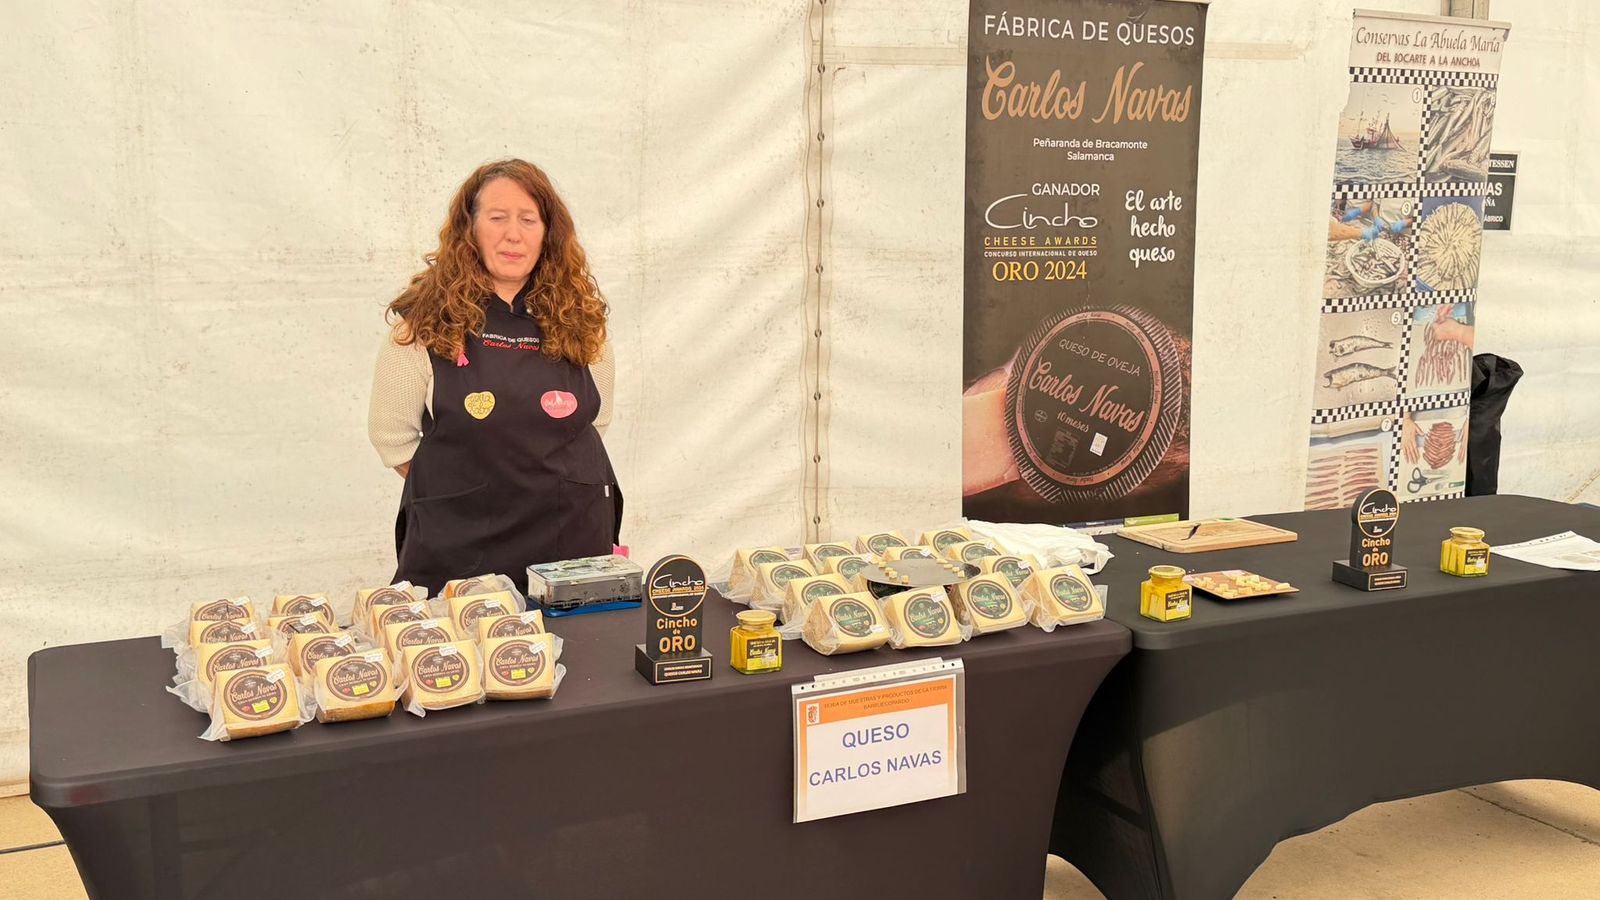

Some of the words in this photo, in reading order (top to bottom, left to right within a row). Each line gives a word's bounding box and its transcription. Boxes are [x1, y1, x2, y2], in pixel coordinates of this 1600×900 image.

[984, 11, 1074, 40] FÁBRICA
[1082, 21, 1109, 41] DE
[1116, 23, 1195, 46] QUESOS
[1356, 26, 1410, 49] Conservas
[1413, 31, 1428, 48] La
[1430, 32, 1467, 51] Abuela
[1470, 35, 1500, 53] María
[1376, 52, 1391, 63] DEL
[1394, 53, 1426, 64] BOCARTE
[1429, 55, 1436, 65] A
[1438, 55, 1449, 66] LA
[1450, 56, 1481, 68] ANCHOA
[981, 55, 1087, 121] Carlos
[1091, 61, 1193, 124] Navas
[1033, 138, 1080, 149] Peñaranda
[1082, 139, 1094, 149] de
[1095, 139, 1148, 150] Bracamonte
[1067, 151, 1115, 161] Salamanca
[1032, 183, 1100, 196] GANADOR
[1125, 189, 1145, 212] El
[1150, 190, 1183, 212] arte
[984, 193, 1098, 230] Cincho
[1130, 215, 1176, 238] hecho
[984, 236, 1036, 246] CHEESE
[1044, 236, 1098, 246] AWARDS
[984, 250, 1018, 258] CONCURSO
[1019, 250, 1066, 258] INTERNACIONAL
[1129, 246, 1176, 269] queso
[992, 261, 1039, 281] ORO
[1044, 260, 1088, 280] 2024
[1059, 338, 1090, 357] QUESO
[1090, 350, 1106, 363] DE
[1107, 356, 1141, 377] OVEJA
[1029, 356, 1084, 406] Carlos
[1079, 384, 1145, 433] Navas
[1361, 502, 1397, 515] Cincho
[1362, 538, 1391, 548] Cincho
[1362, 552, 1388, 567] ORO
[653, 574, 704, 588] Cincho
[656, 616, 698, 630] Cincho
[659, 634, 696, 654] ORO
[496, 656, 517, 666] Carlos
[518, 650, 539, 664] Navas
[418, 664, 440, 674] Carlos
[441, 660, 462, 672] Navas
[334, 673, 356, 684] Carlos
[357, 668, 378, 680] Navas
[232, 688, 255, 700] Carlos
[256, 684, 278, 696] Navas
[842, 723, 910, 748] QUESO
[809, 761, 882, 786] CARLOS
[887, 750, 942, 773] NAVAS
